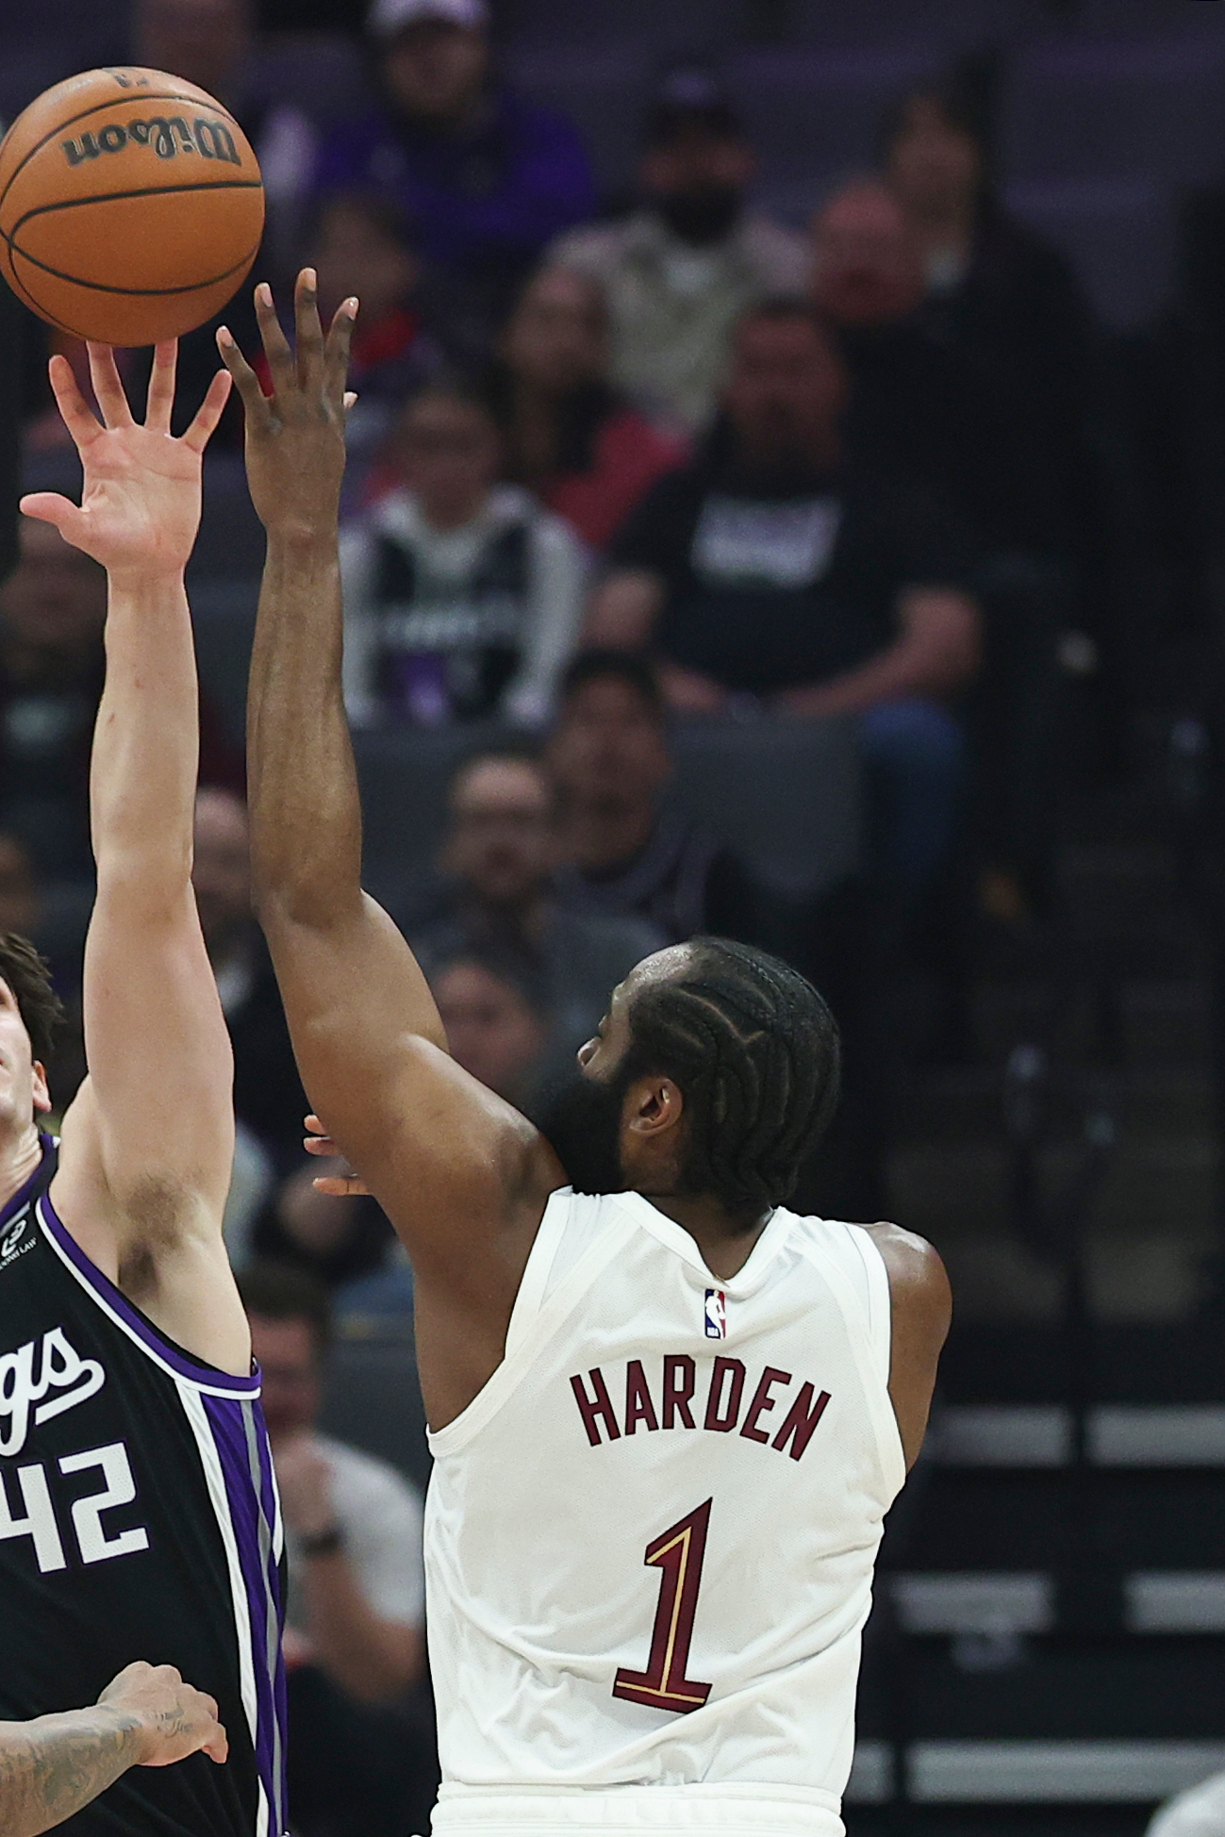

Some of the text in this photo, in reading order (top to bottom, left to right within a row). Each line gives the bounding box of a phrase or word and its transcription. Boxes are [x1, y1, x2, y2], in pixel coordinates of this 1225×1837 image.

[60, 115, 242, 167] Wilson
[569, 1353, 832, 1462] HARDEN
[612, 1497, 715, 1715] 1
